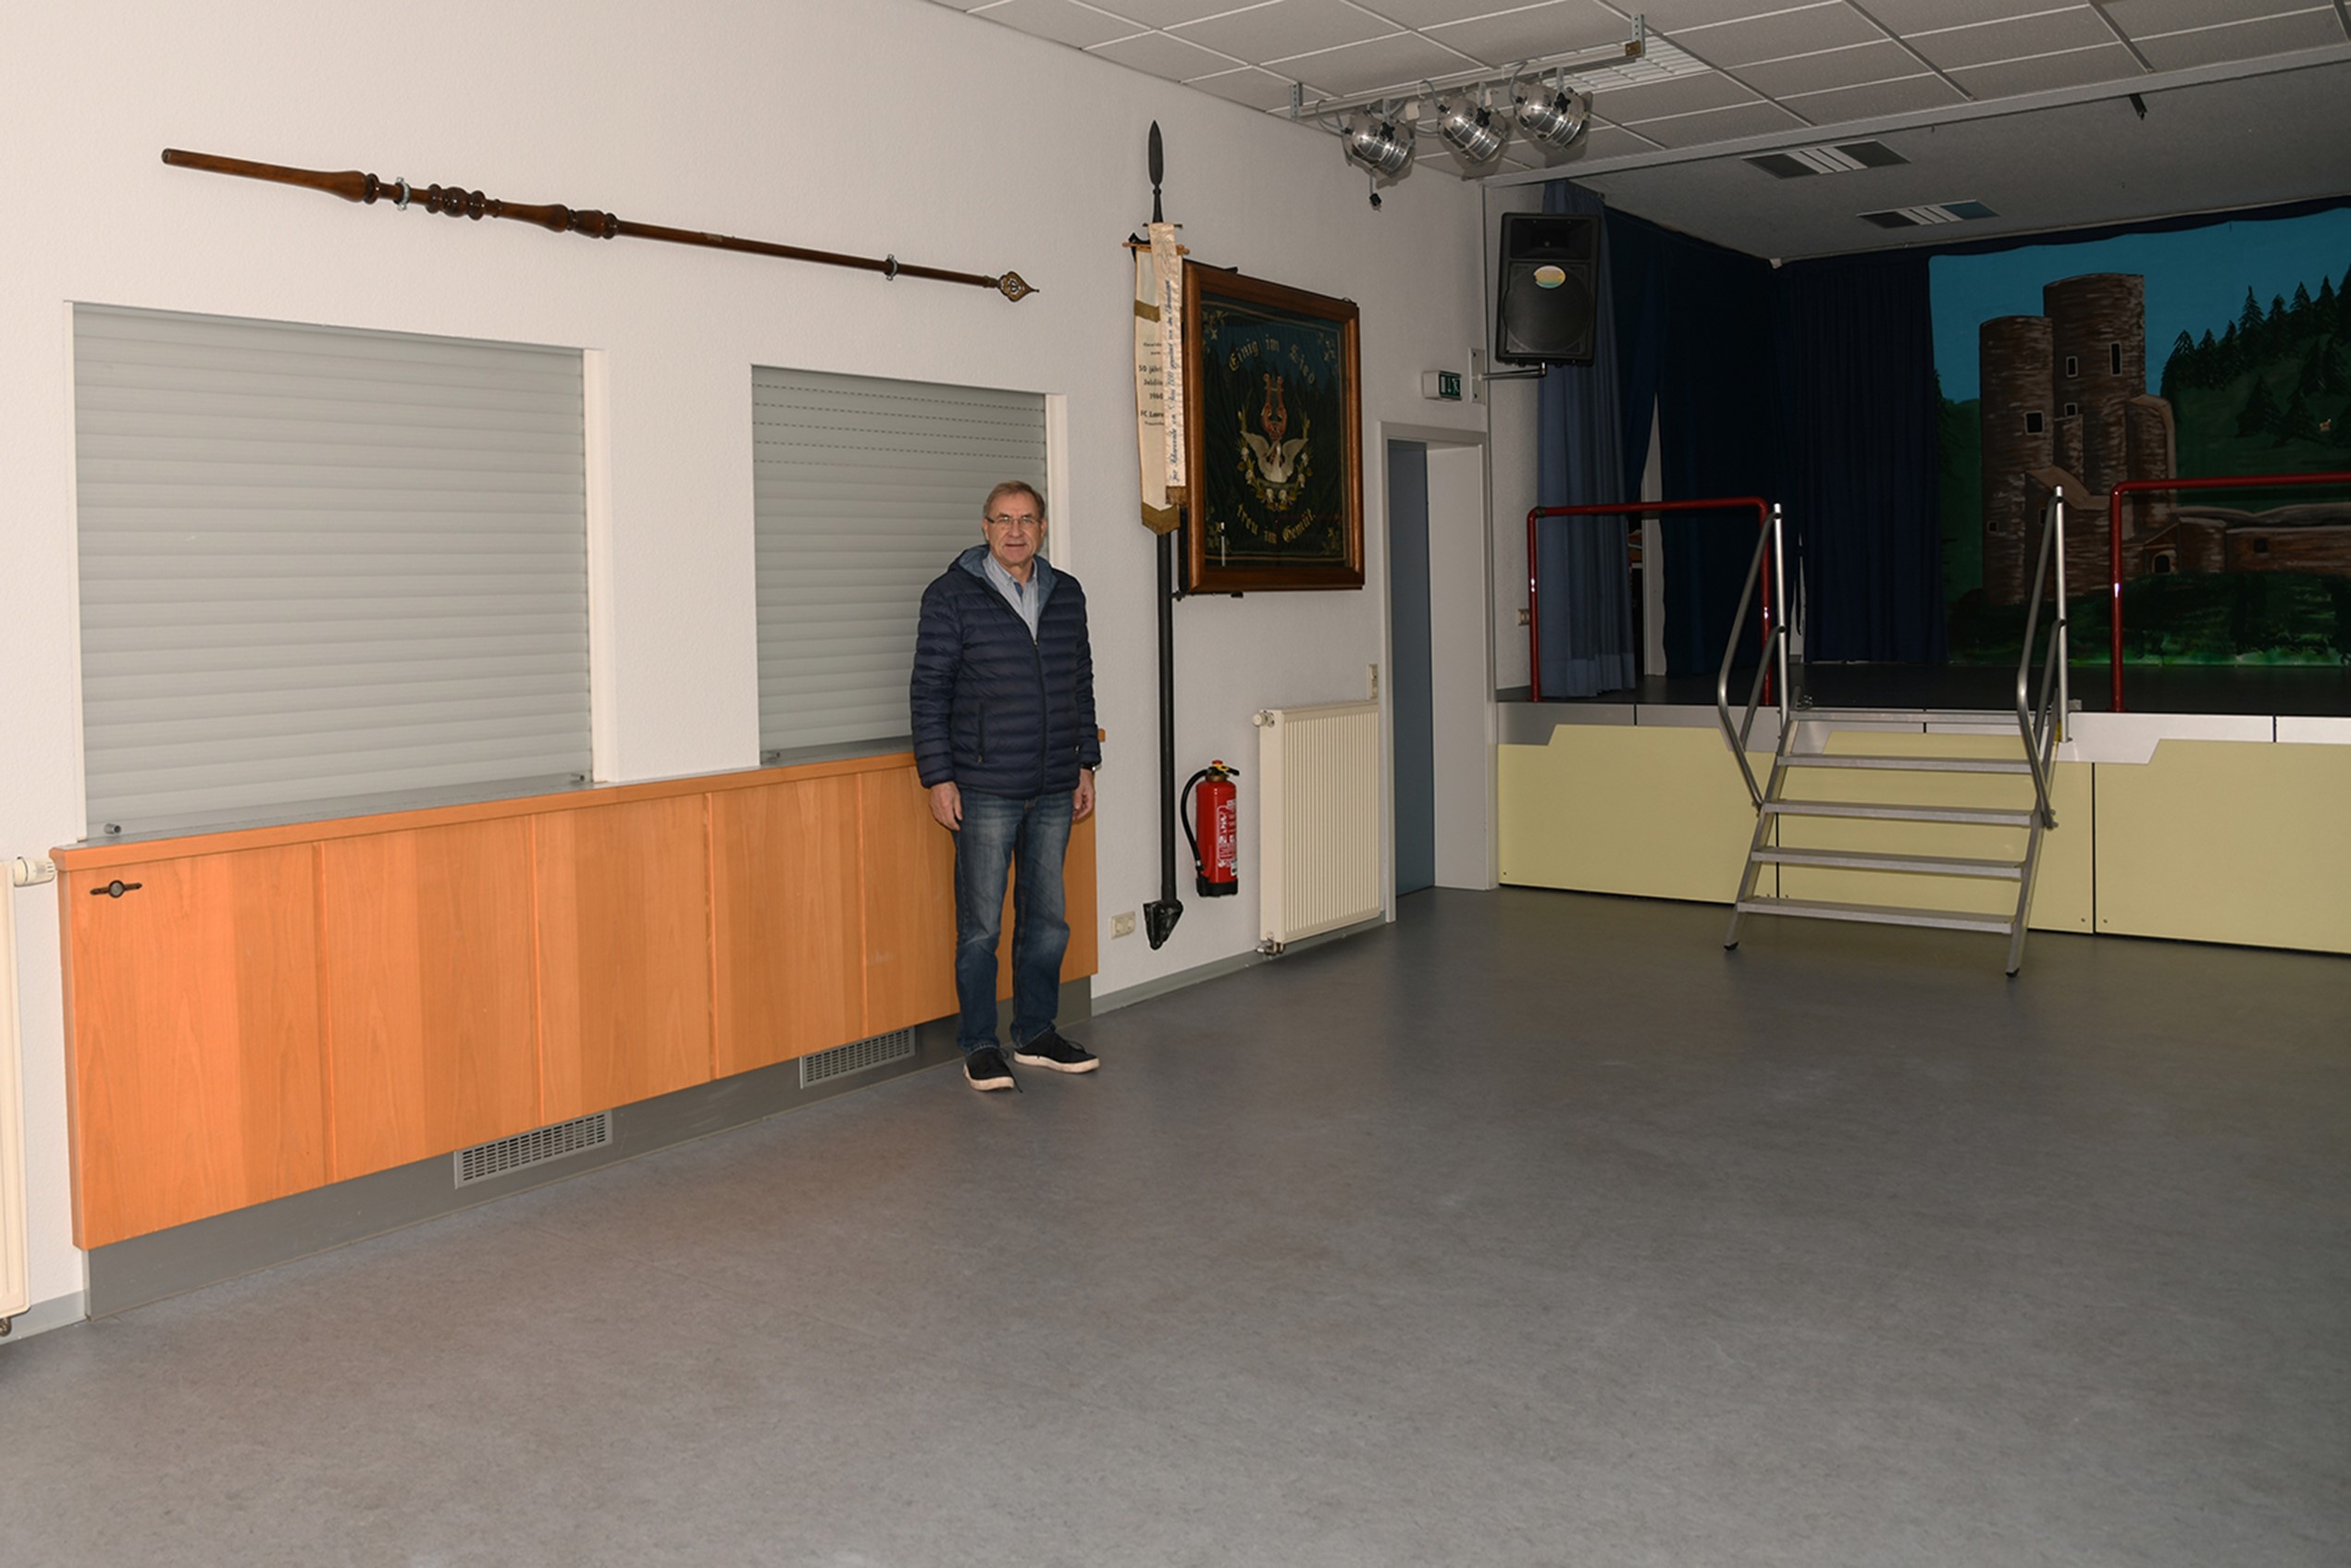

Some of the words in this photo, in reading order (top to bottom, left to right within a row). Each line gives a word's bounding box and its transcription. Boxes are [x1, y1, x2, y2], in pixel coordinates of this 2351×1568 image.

[1229, 338, 1260, 372] Einig
[1265, 333, 1280, 352] im
[1263, 525, 1278, 545] im
